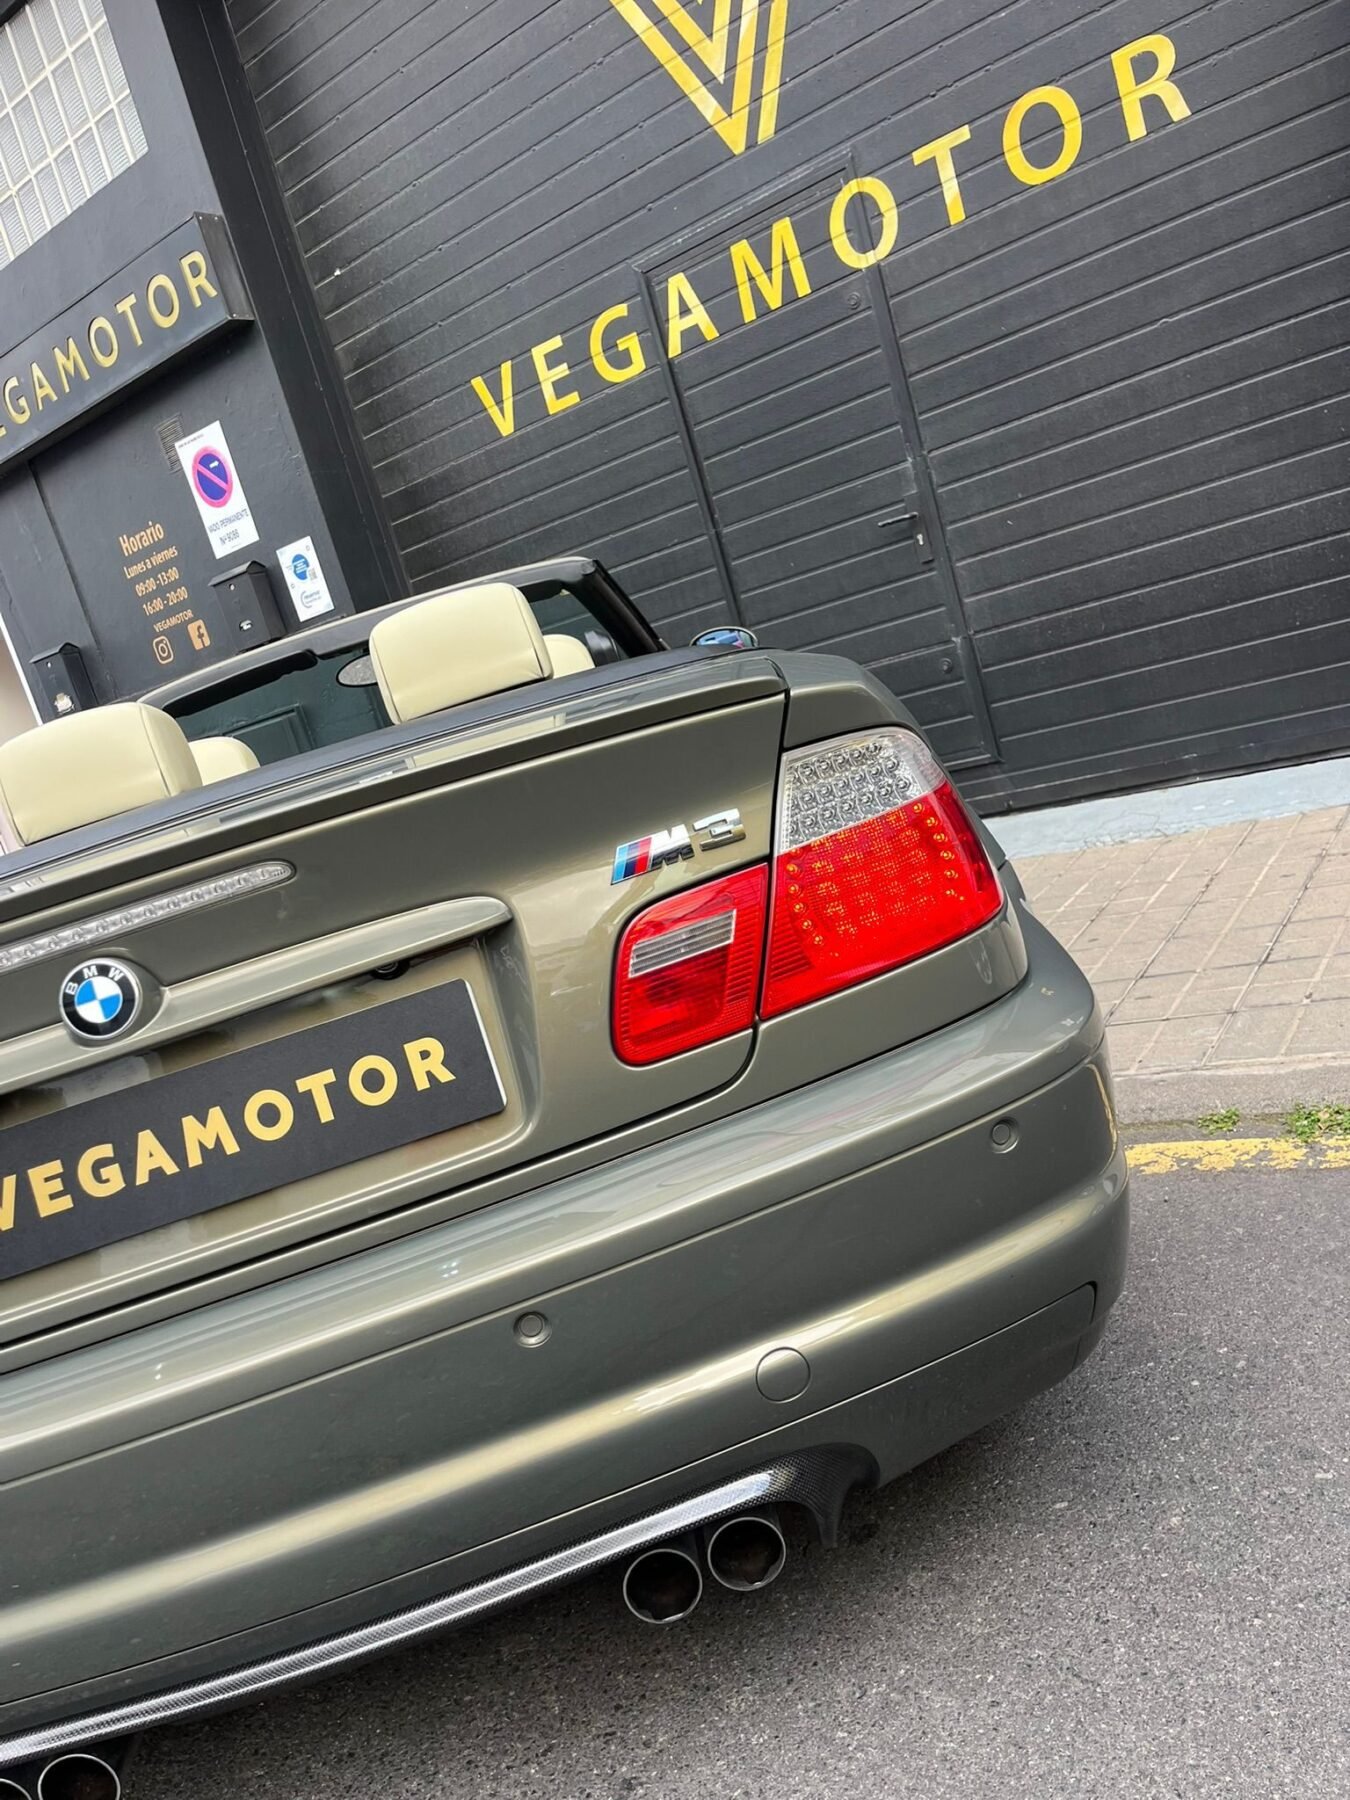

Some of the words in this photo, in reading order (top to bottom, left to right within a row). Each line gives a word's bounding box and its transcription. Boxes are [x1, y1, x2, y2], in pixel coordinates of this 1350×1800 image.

[470, 33, 1192, 437] VEGAMOTOR
[0, 250, 218, 438] GAMOTOR
[119, 521, 164, 556] Horario
[123, 563, 147, 580] Lunes
[145, 557, 152, 568] a
[151, 545, 178, 564] viernes
[135, 576, 157, 597] 09:00
[157, 567, 179, 587] 13:00
[142, 596, 163, 617] 16:00
[166, 586, 189, 606] 20:00
[153, 609, 194, 633] VEGAMOTOR
[642, 807, 746, 873] M3
[65, 965, 125, 995] BMW
